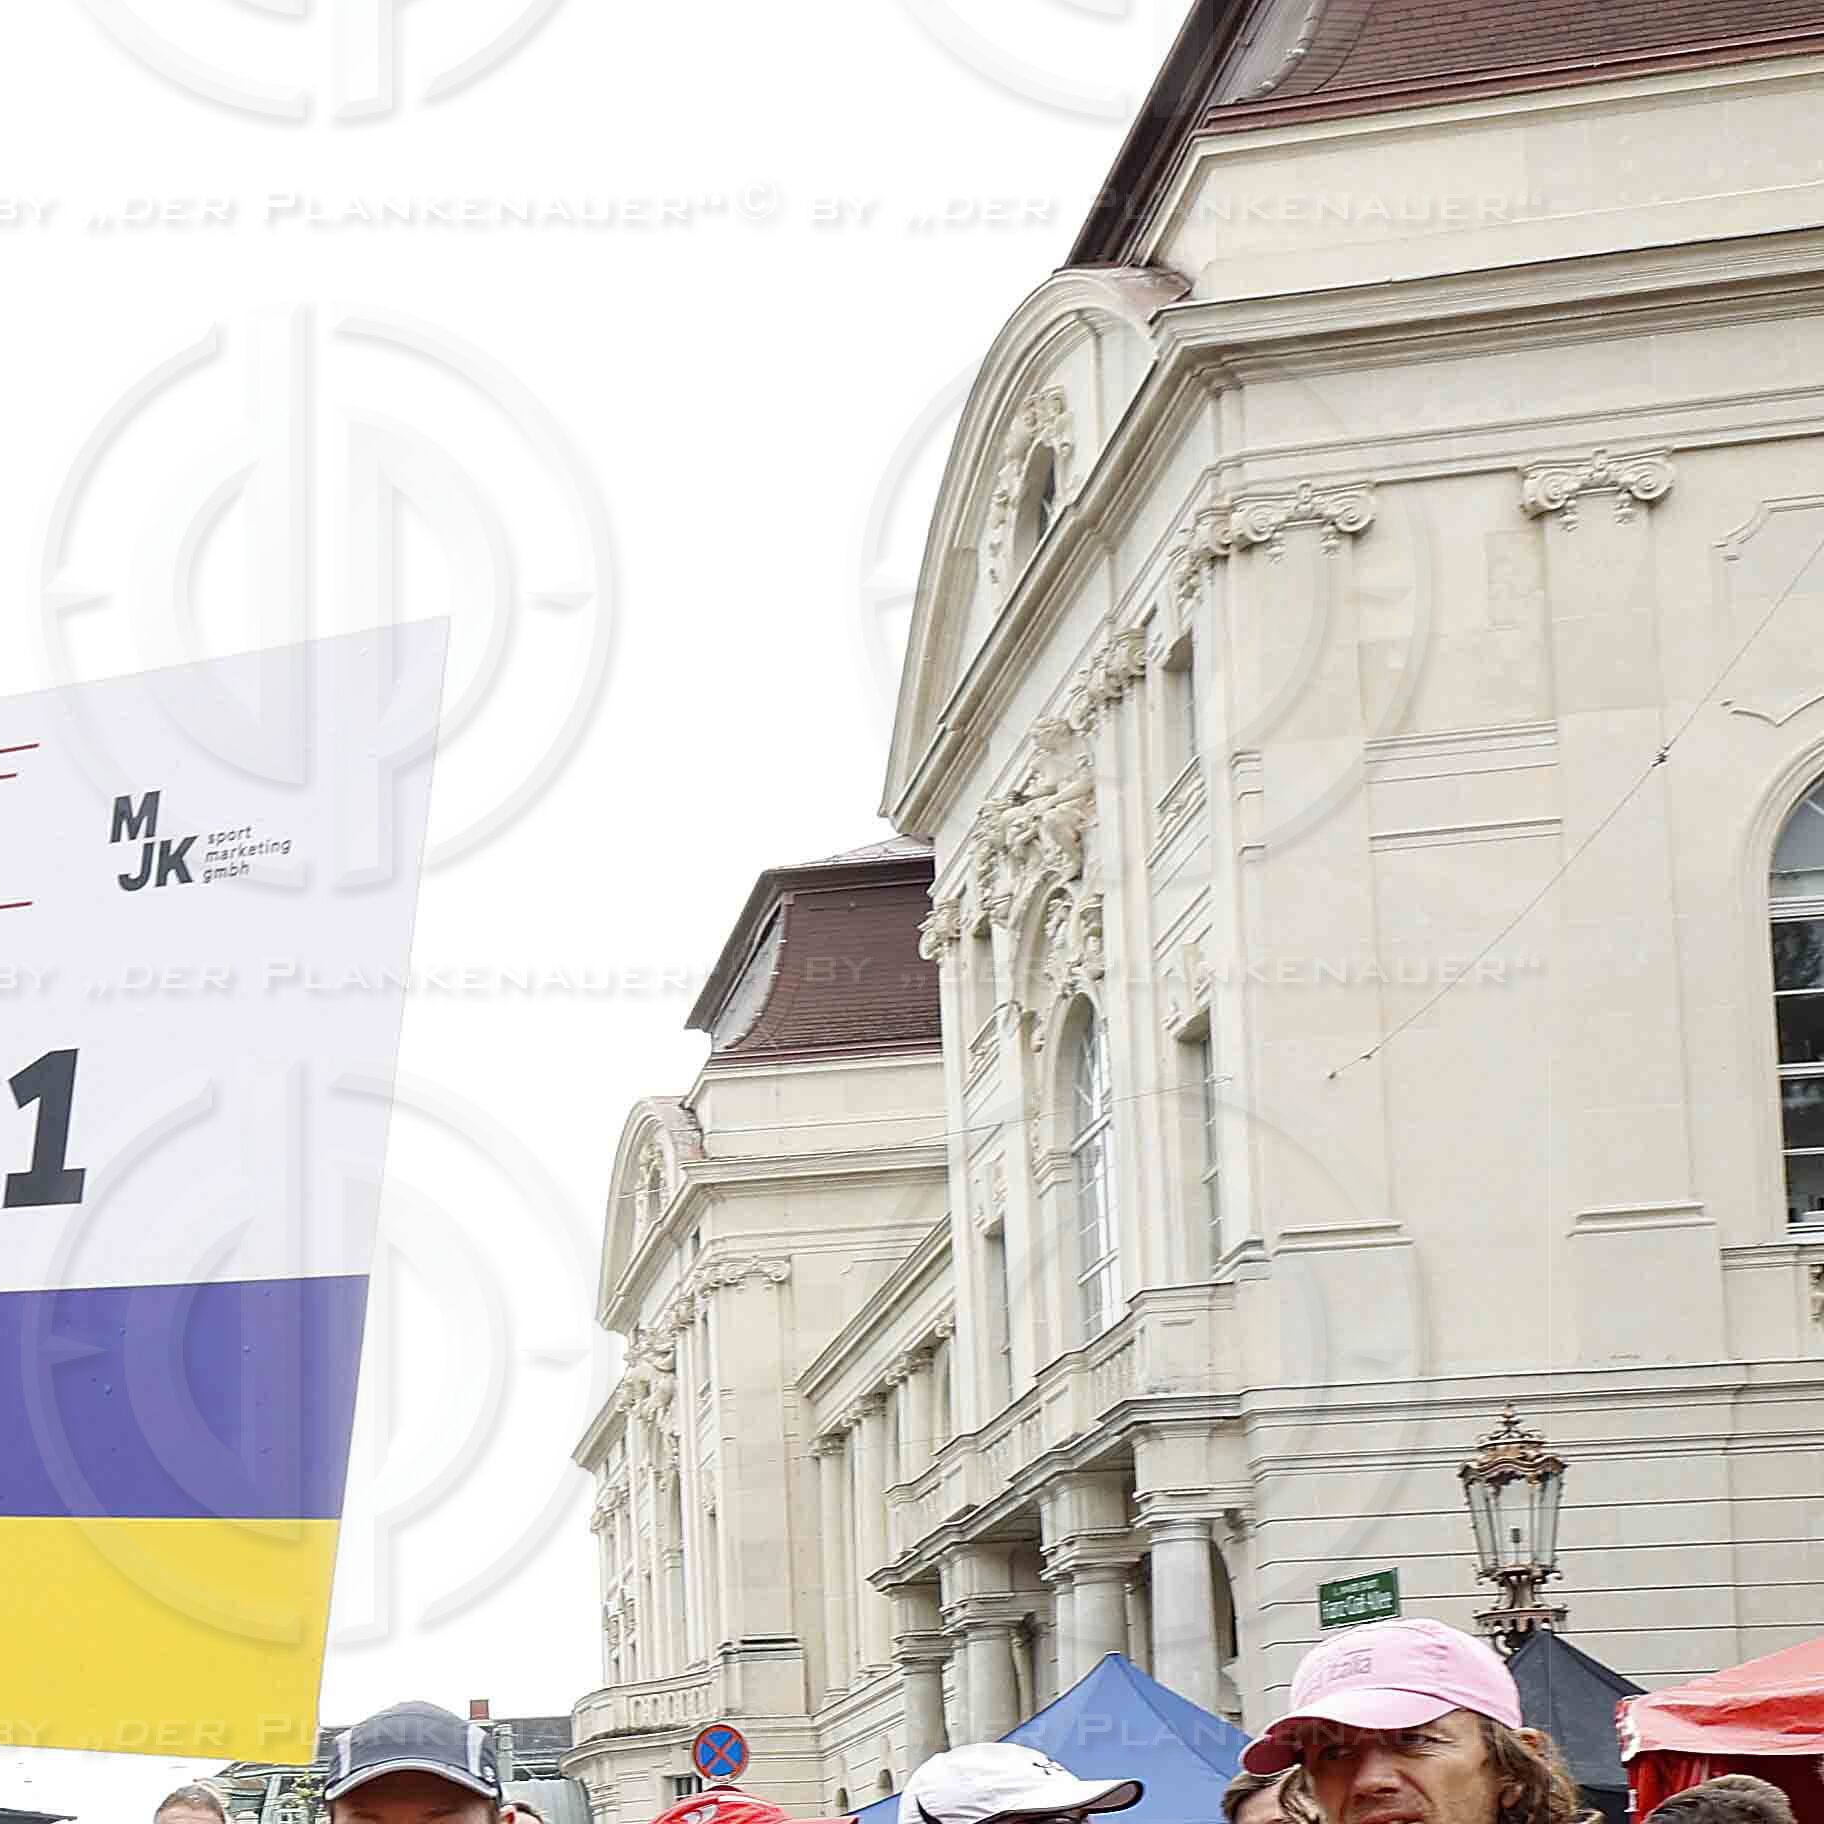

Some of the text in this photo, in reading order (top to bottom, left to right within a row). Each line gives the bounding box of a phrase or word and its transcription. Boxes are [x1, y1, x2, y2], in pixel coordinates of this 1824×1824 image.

[206, 824, 254, 848] sport
[204, 836, 292, 865] marketing
[202, 860, 251, 885] gmbh
[1, 1048, 87, 1209] 1
